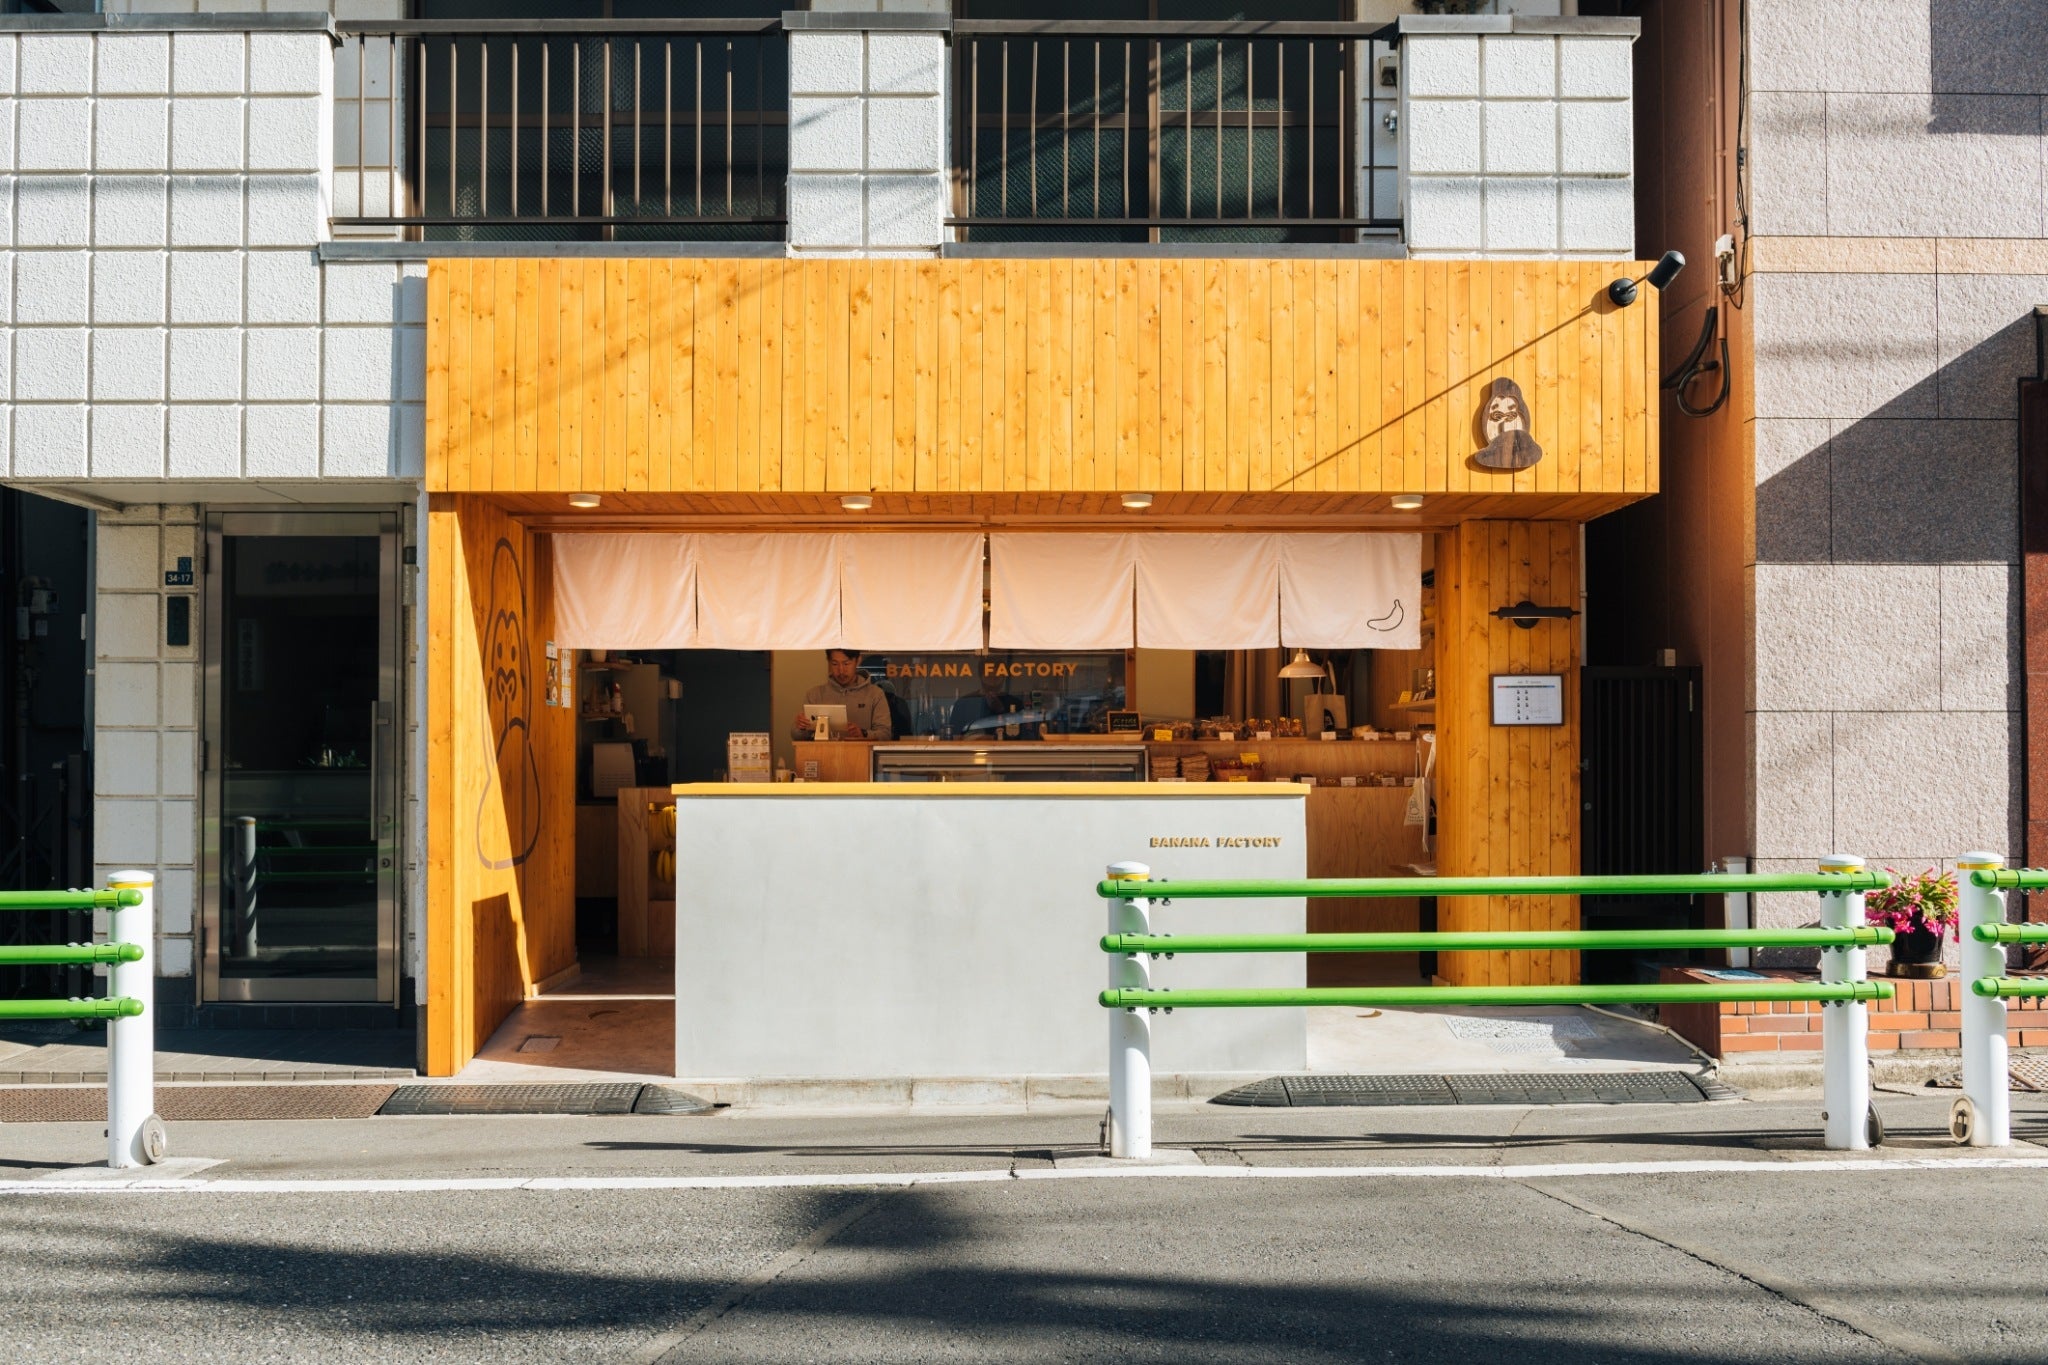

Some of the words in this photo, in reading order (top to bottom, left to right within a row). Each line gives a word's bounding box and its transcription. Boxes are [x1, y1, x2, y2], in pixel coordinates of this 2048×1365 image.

[886, 663, 973, 678] BANANA
[984, 663, 1078, 677] FACTORY
[1150, 836, 1210, 848] BANANA
[1216, 836, 1281, 848] FACTORY
